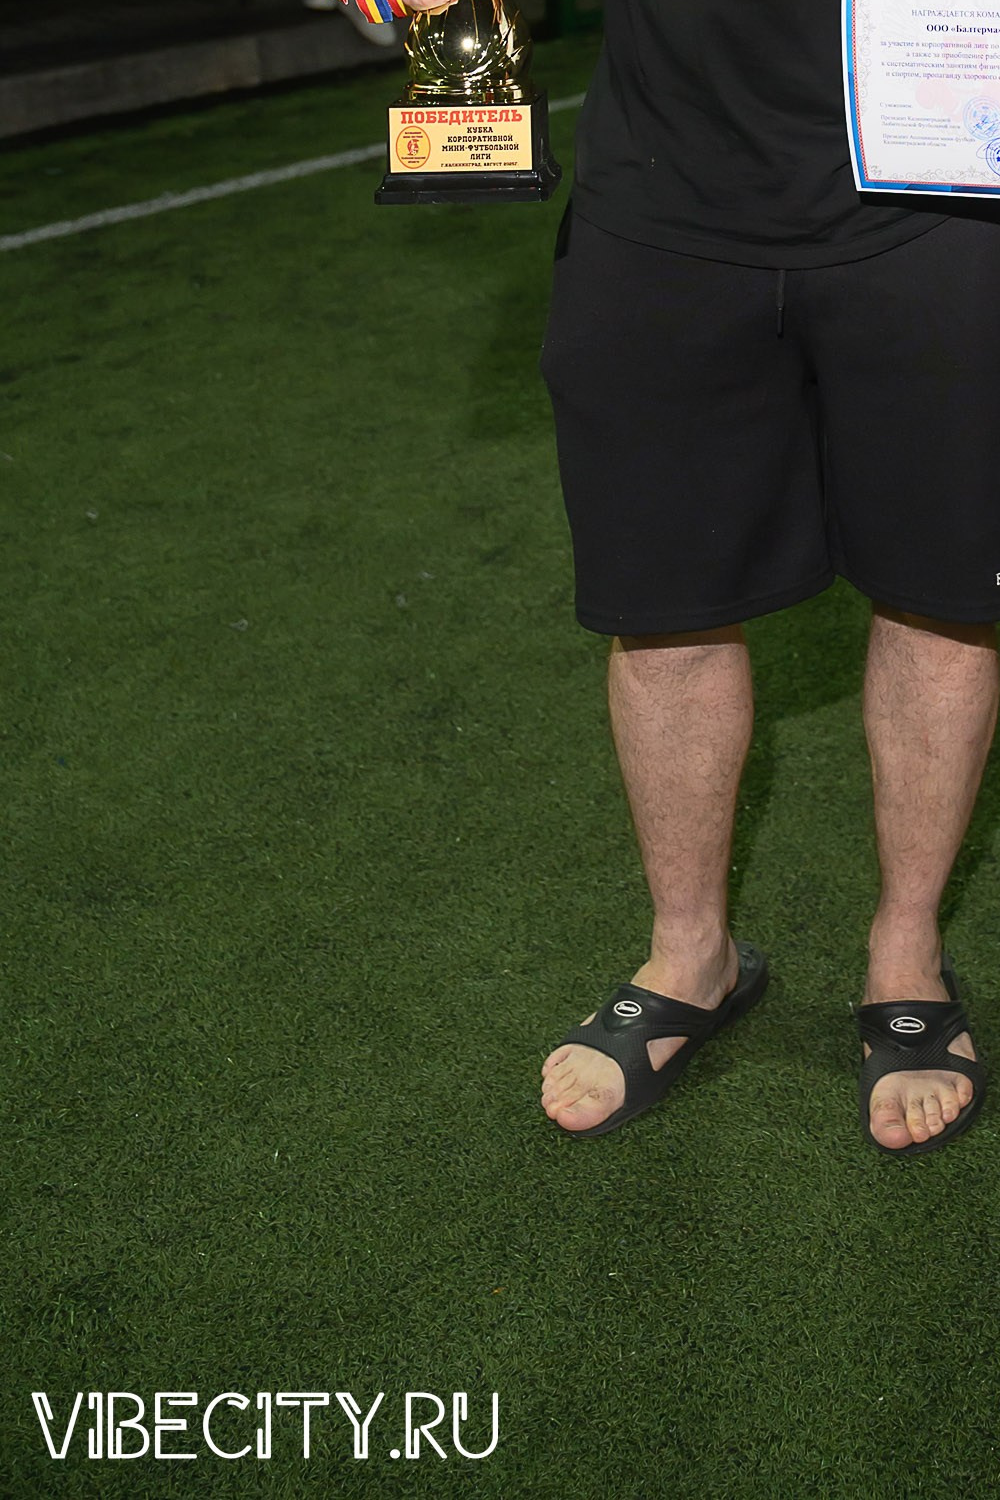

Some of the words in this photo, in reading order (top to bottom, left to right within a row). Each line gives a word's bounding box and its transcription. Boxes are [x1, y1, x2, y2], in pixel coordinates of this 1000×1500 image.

[911, 9, 976, 18] НАГРАЖДАЕТСЯ
[926, 24, 949, 32] ООО
[942, 52, 984, 60] приобщение
[400, 109, 523, 126] ПОБЕДИТЕЛЬ
[466, 126, 494, 134] КУБКА
[448, 134, 514, 143] КОРПОРАТИВНОЙ
[442, 143, 519, 152] МИНИ-ФУТБОЛЬНОЙ
